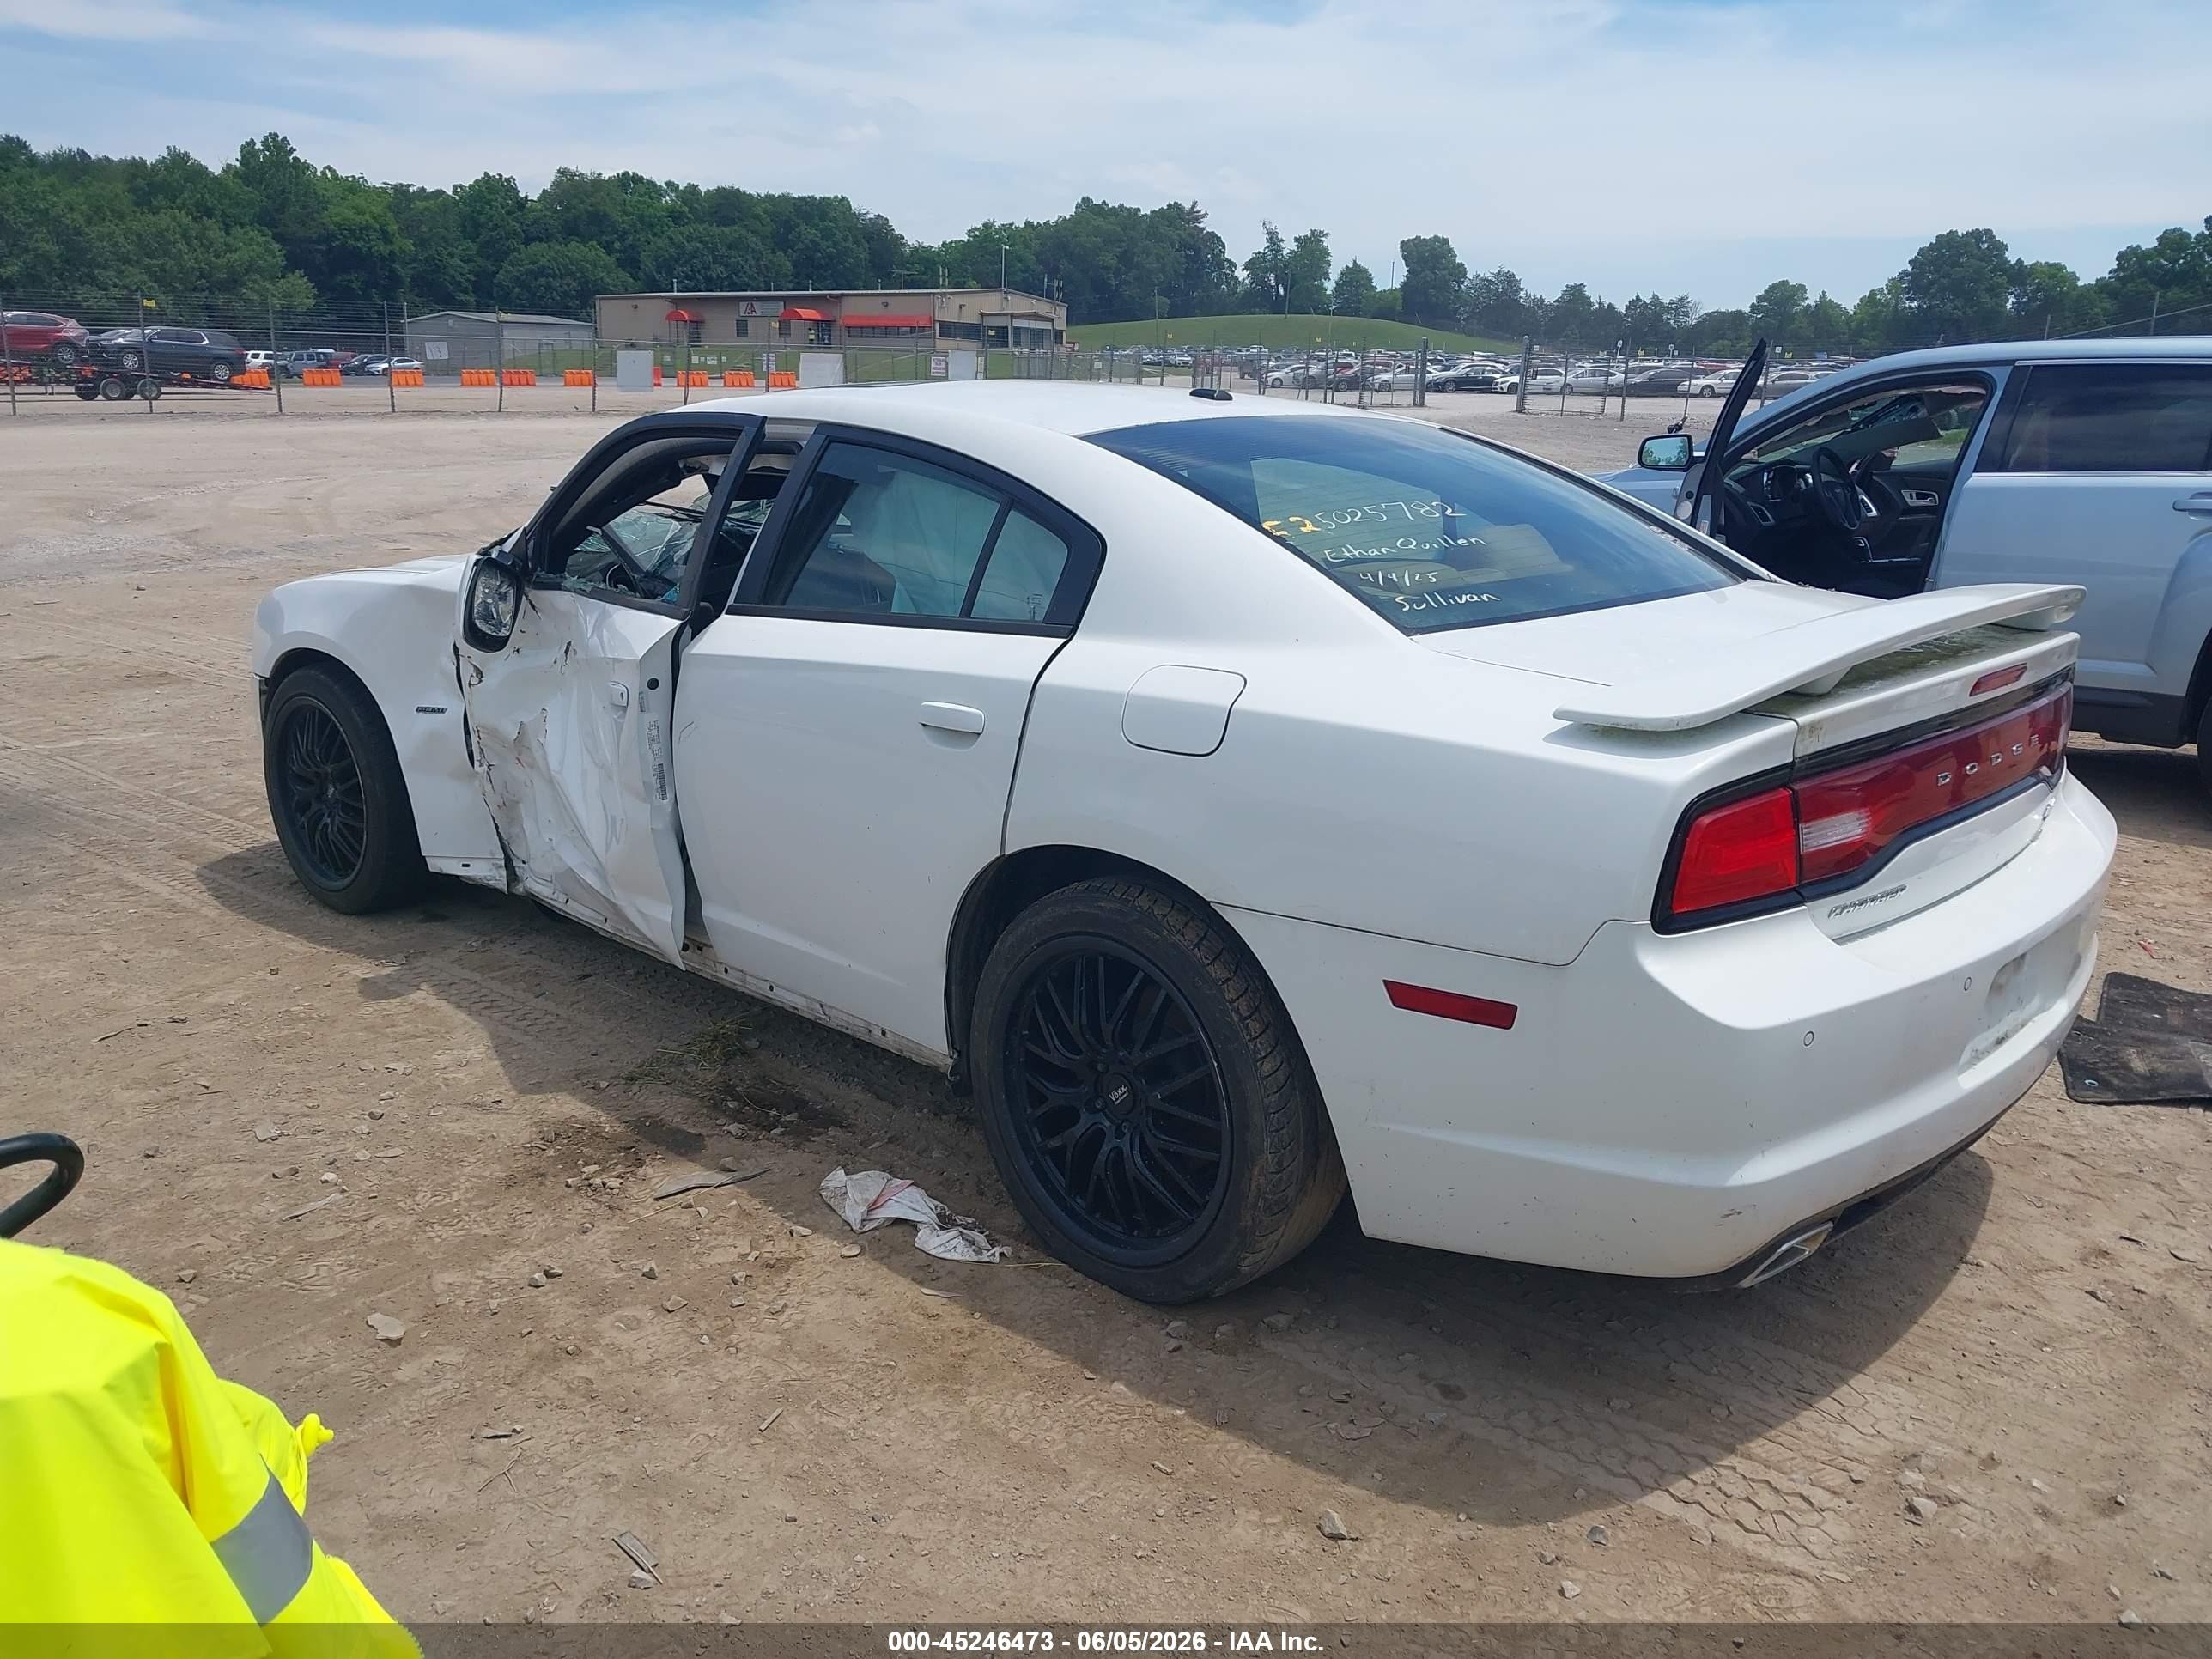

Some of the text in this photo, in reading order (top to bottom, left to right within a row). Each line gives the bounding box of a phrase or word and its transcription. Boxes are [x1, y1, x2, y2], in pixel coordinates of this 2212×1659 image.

[1323, 544, 1397, 562] Ethan
[1359, 569, 1439, 586] 4/4/25
[1395, 592, 1502, 611] Sullivan
[1937, 734, 2040, 787] DODGE
